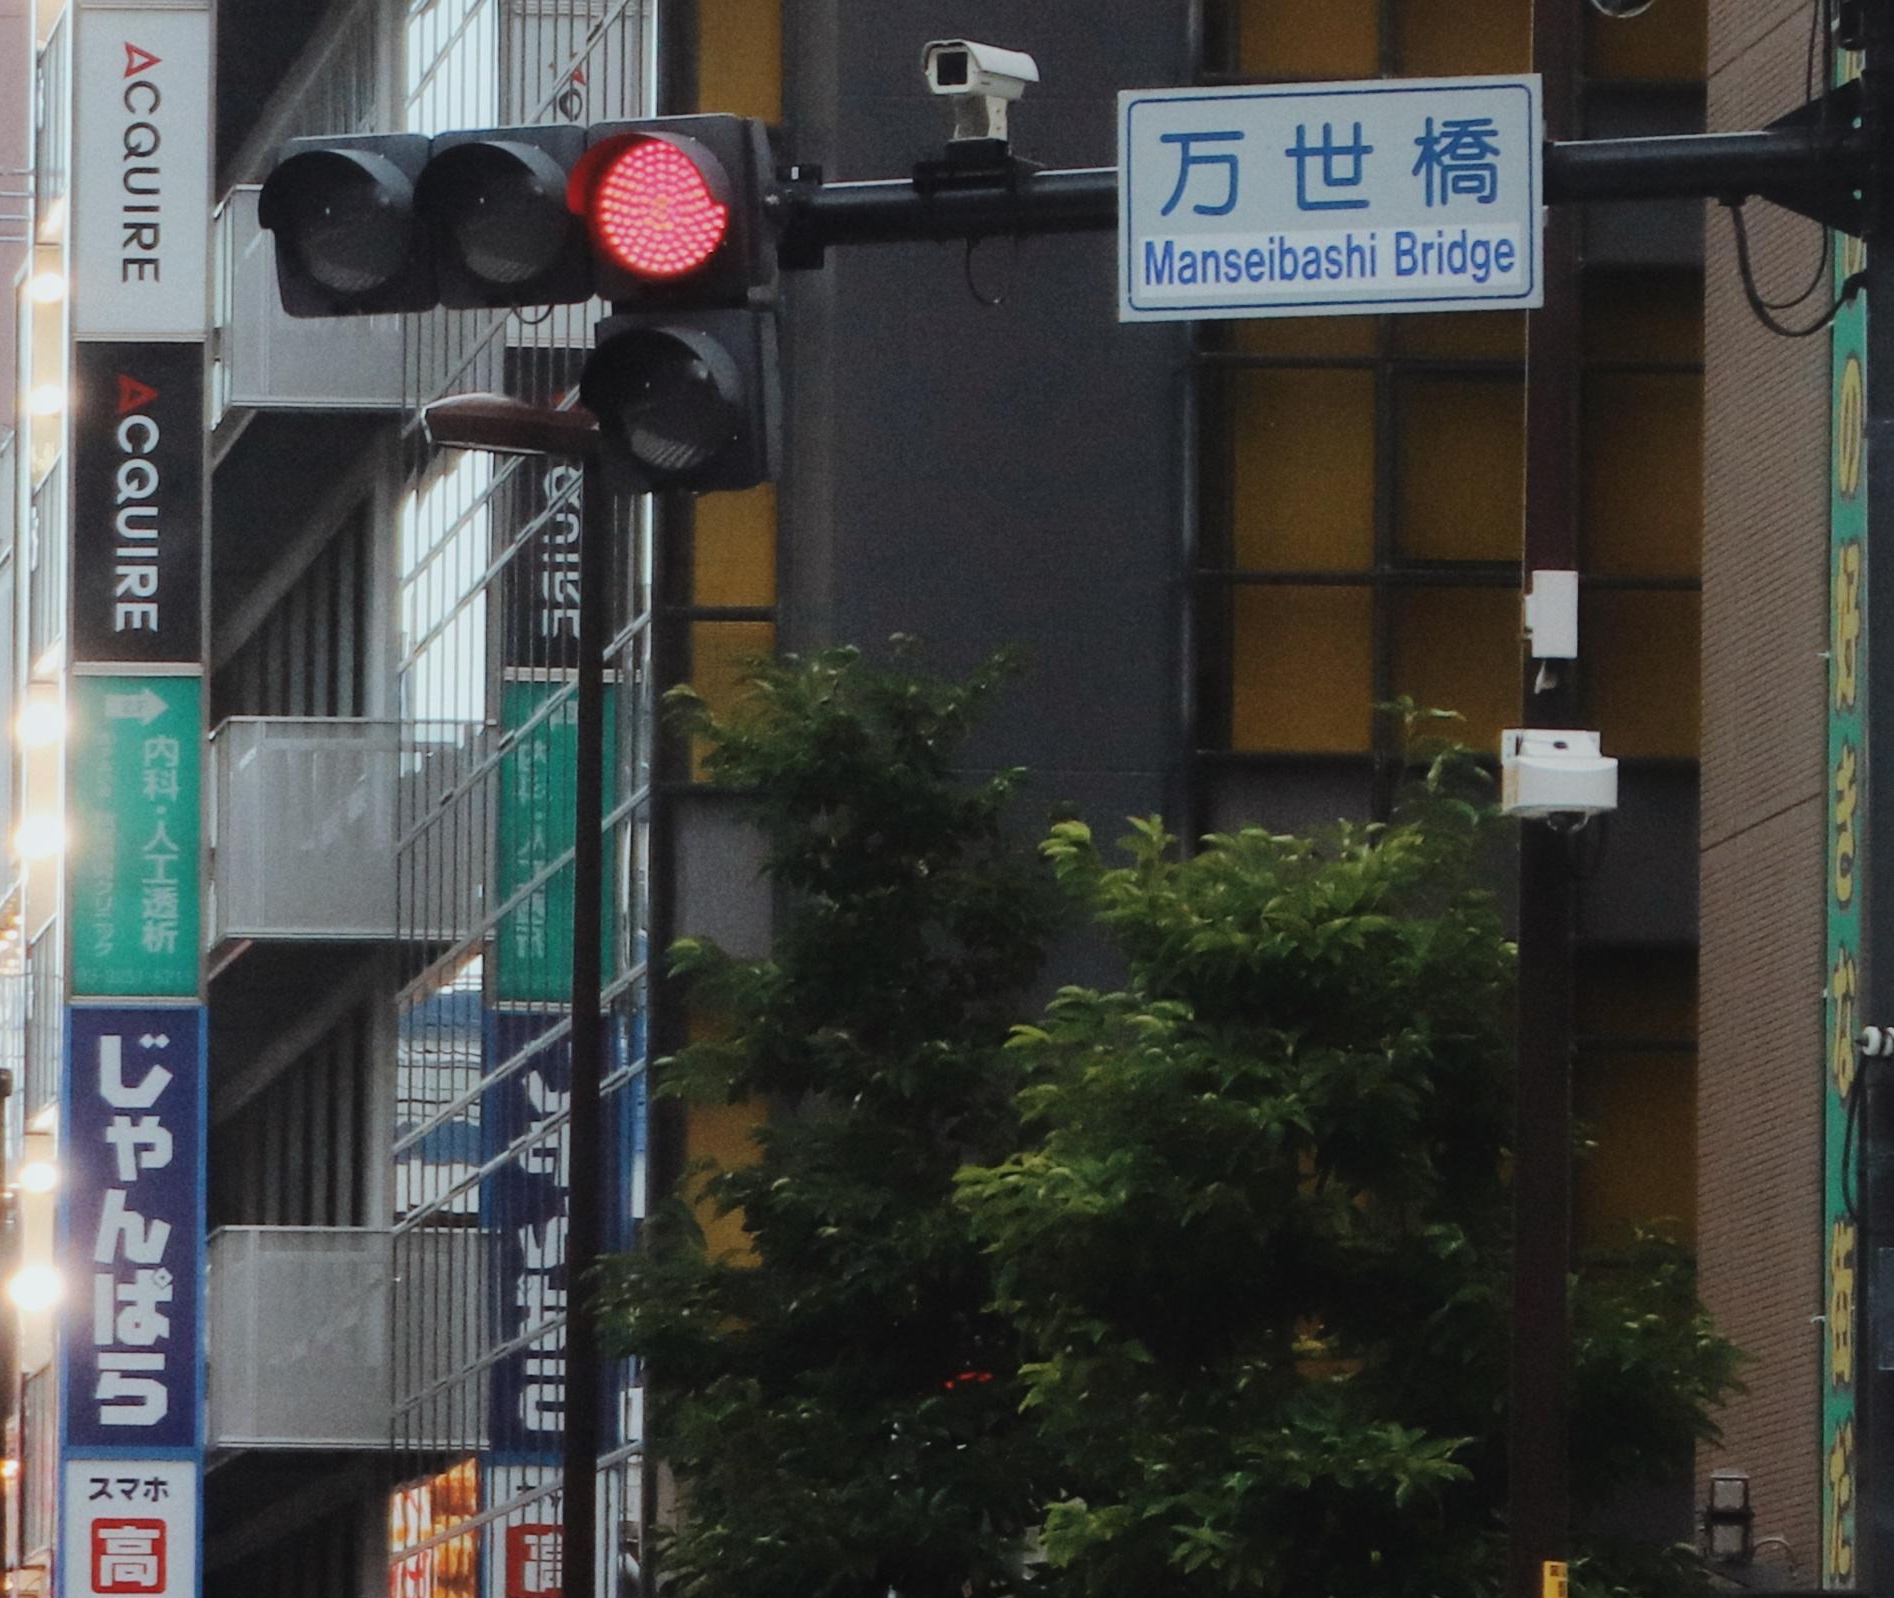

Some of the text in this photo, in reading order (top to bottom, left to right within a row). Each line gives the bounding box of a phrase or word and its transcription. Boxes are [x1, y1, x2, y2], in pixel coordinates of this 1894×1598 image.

[122, 41, 162, 284] ACQUIRE
[1144, 229, 1516, 286] Manseibashi Bridge
[1159, 116, 1500, 216] 万世橋
[116, 373, 160, 633] ACQUIRE
[141, 734, 181, 954] 内科・人工透析
[93, 1032, 174, 1428] じゃんぱら
[87, 1475, 171, 1502] スマホ
